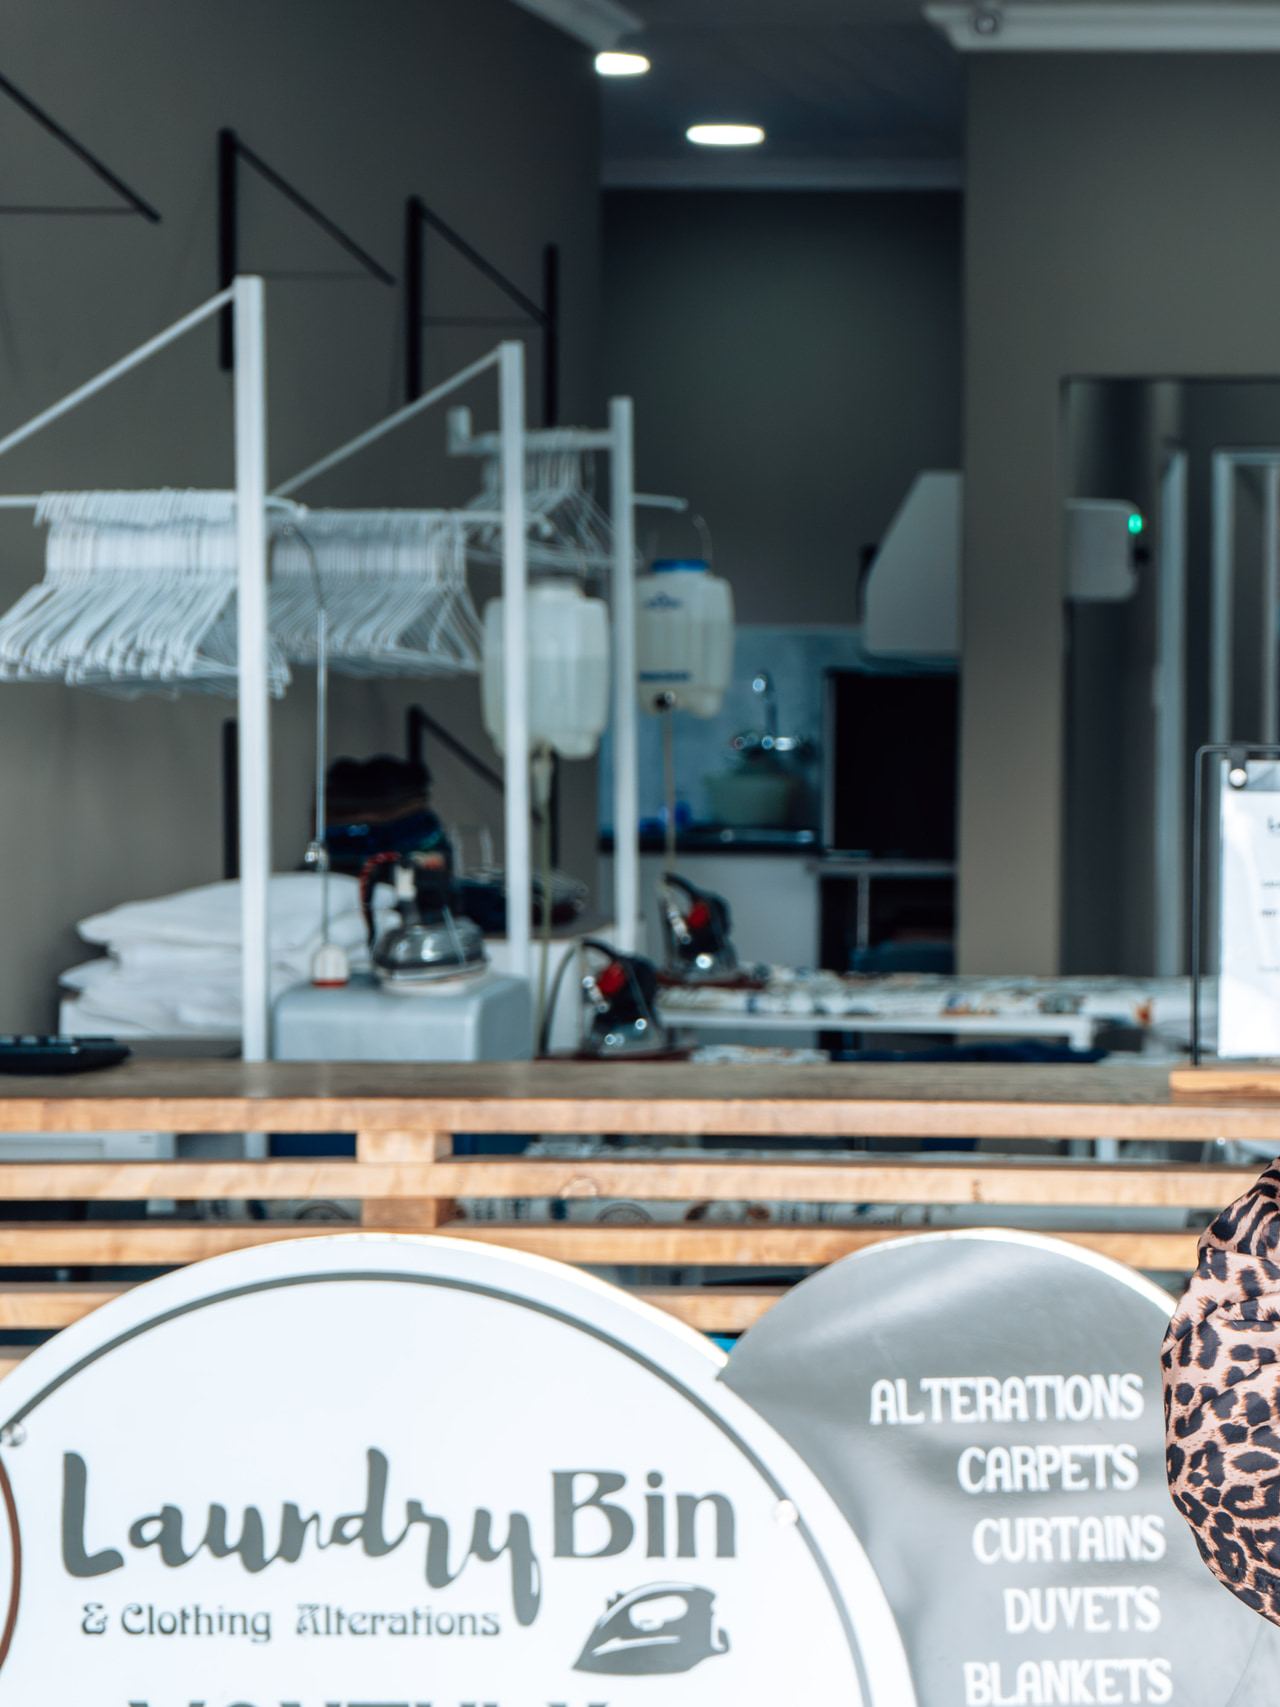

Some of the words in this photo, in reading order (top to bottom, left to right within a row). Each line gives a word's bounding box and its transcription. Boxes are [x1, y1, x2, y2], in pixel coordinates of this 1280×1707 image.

[870, 1373, 1144, 1424] ALTERATIONS
[958, 1444, 1138, 1493] CARPETS
[972, 1515, 1166, 1565] CURTAINS
[82, 1604, 108, 1636] &
[120, 1604, 271, 1643] Clothing
[296, 1604, 501, 1637] Alterations
[1003, 1586, 1161, 1633] DUVETS
[963, 1658, 1173, 1707] BLANKETS
